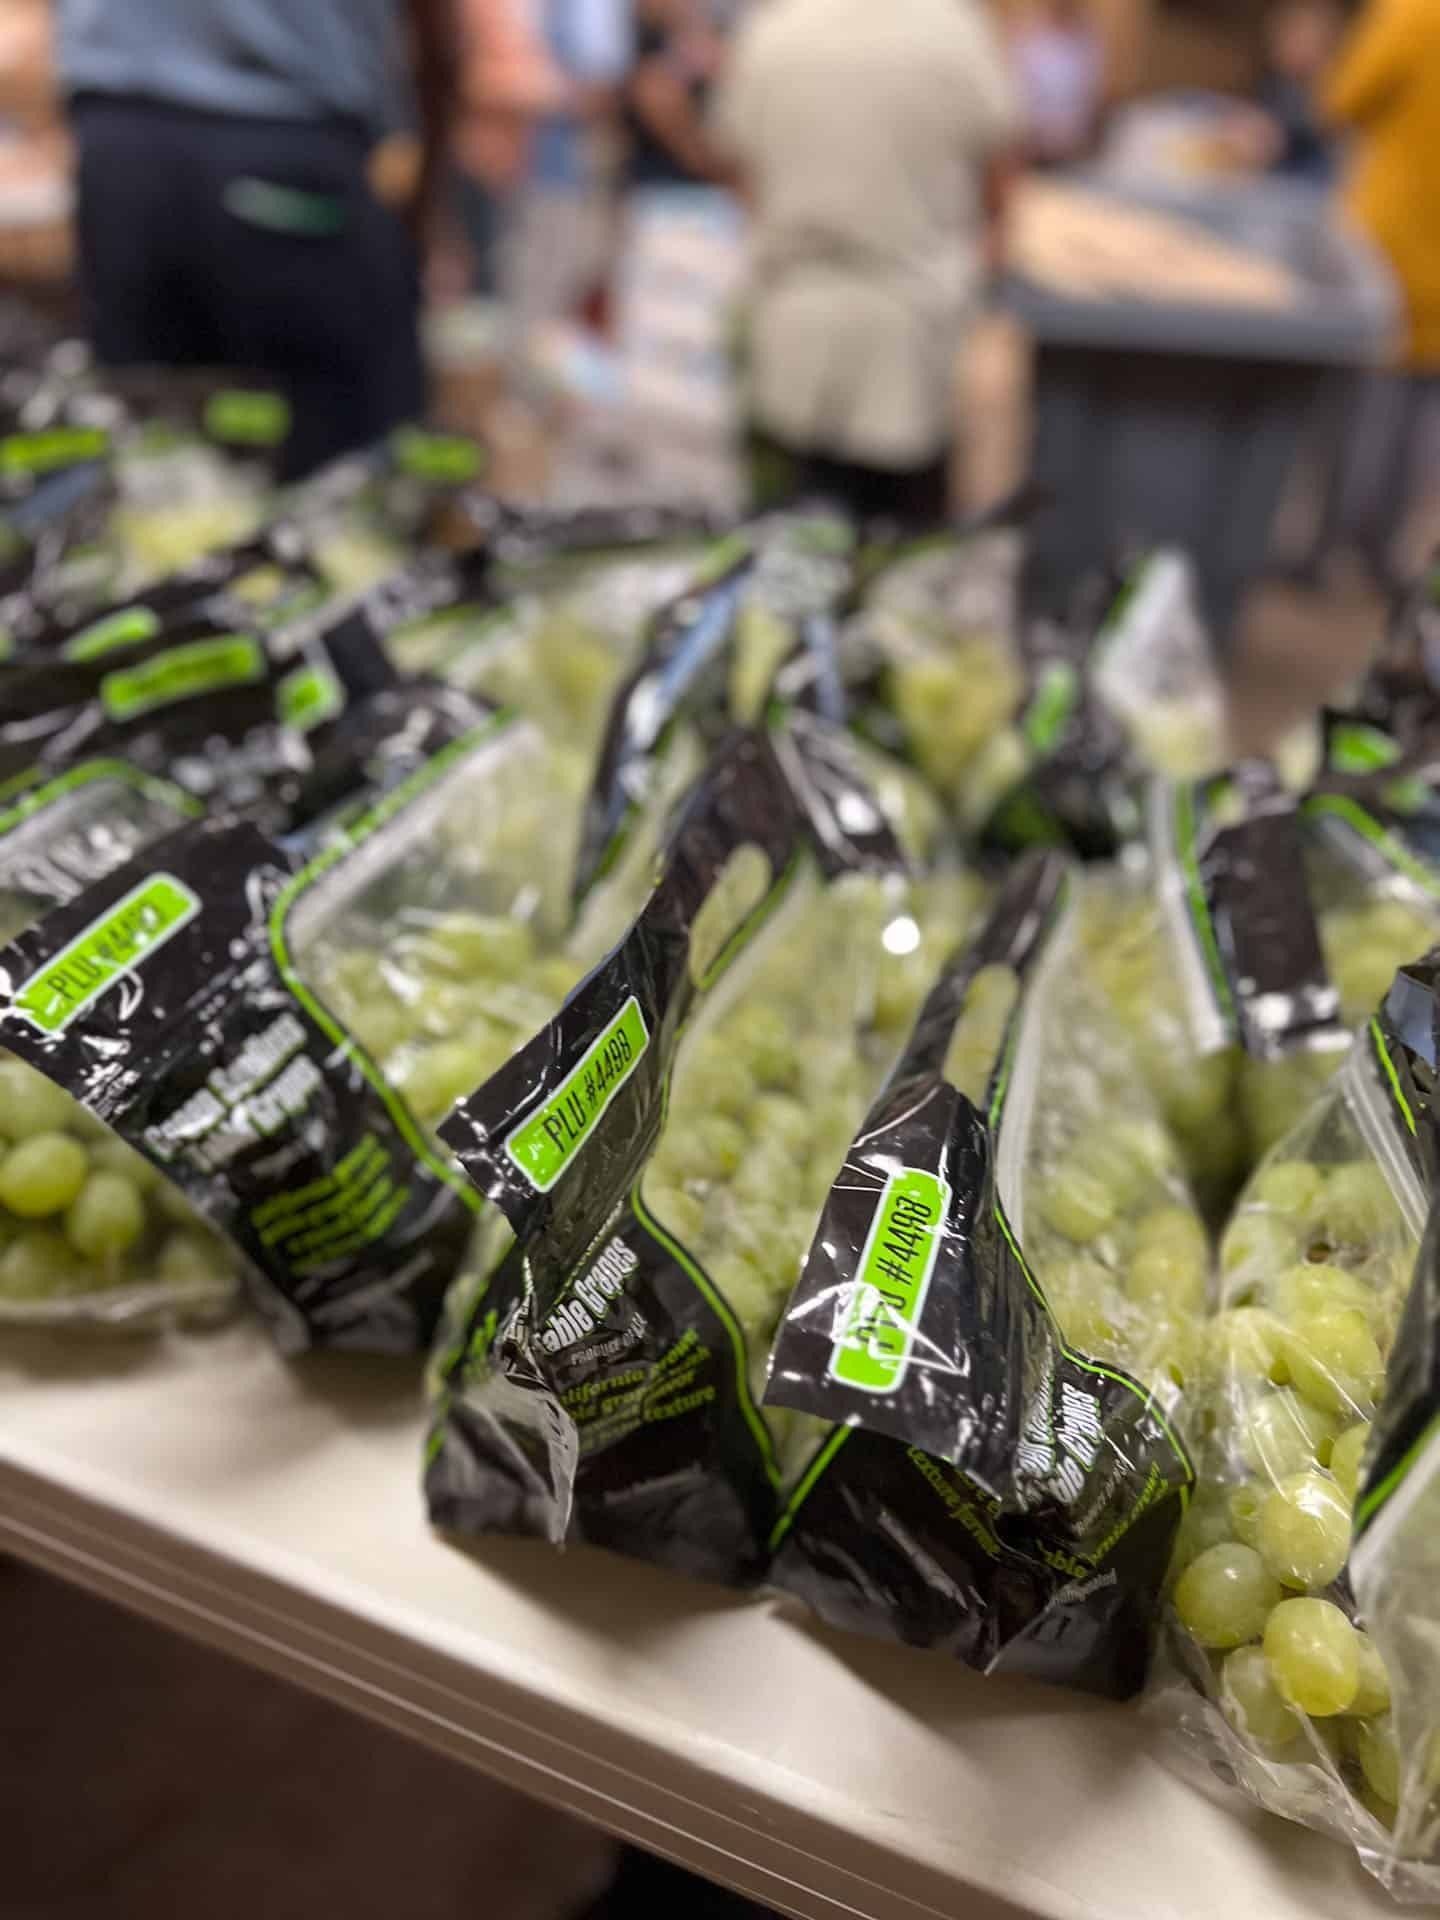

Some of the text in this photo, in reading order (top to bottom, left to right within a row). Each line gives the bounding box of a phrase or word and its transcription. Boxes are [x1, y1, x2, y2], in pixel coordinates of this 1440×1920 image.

[48, 954, 102, 1001] PLU
[542, 1028, 632, 1153] PLU #4498
[574, 1236, 638, 1319] Grapes
[876, 1195, 932, 1286] #4498
[1057, 1381, 1102, 1470] Grapes
